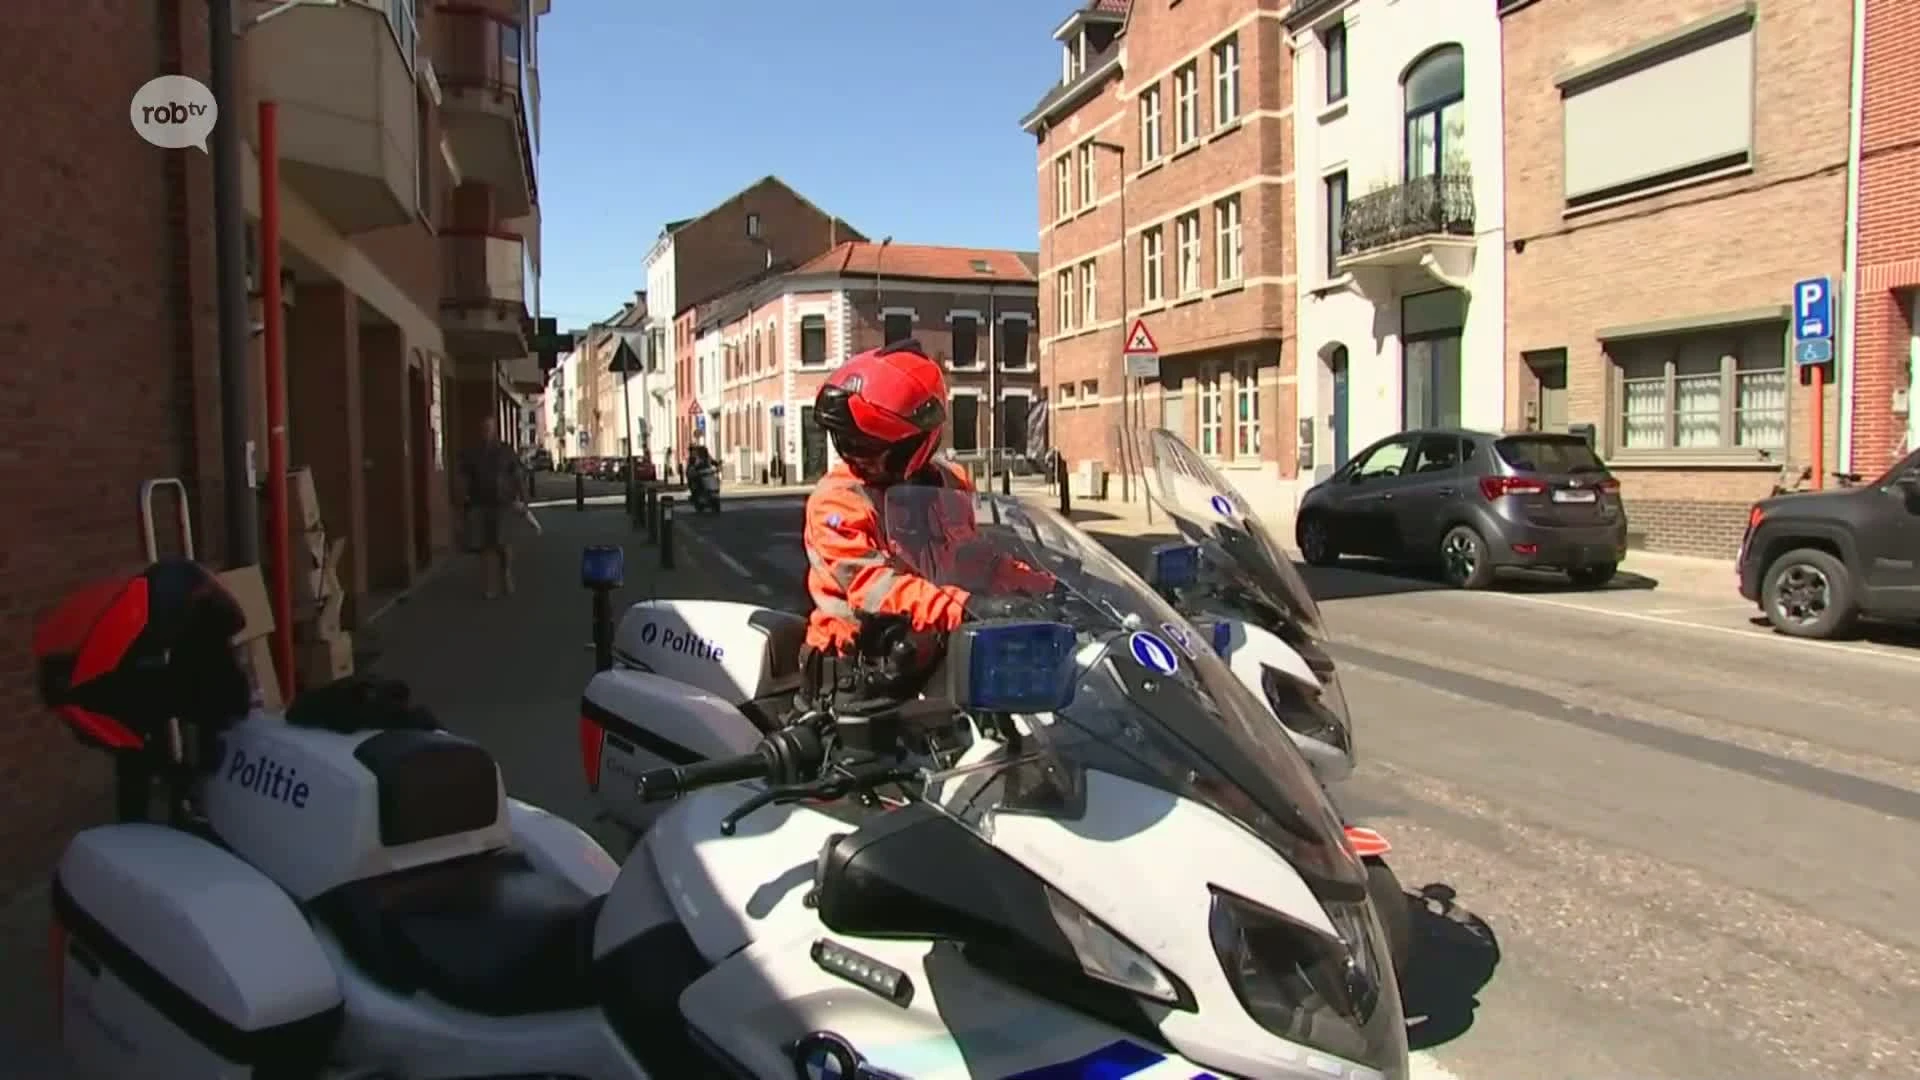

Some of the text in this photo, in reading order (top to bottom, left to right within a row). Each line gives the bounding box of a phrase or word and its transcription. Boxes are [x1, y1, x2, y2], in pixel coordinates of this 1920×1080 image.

[1801, 283, 1823, 317] P
[661, 628, 724, 661] Politie
[228, 749, 310, 809] Politie
